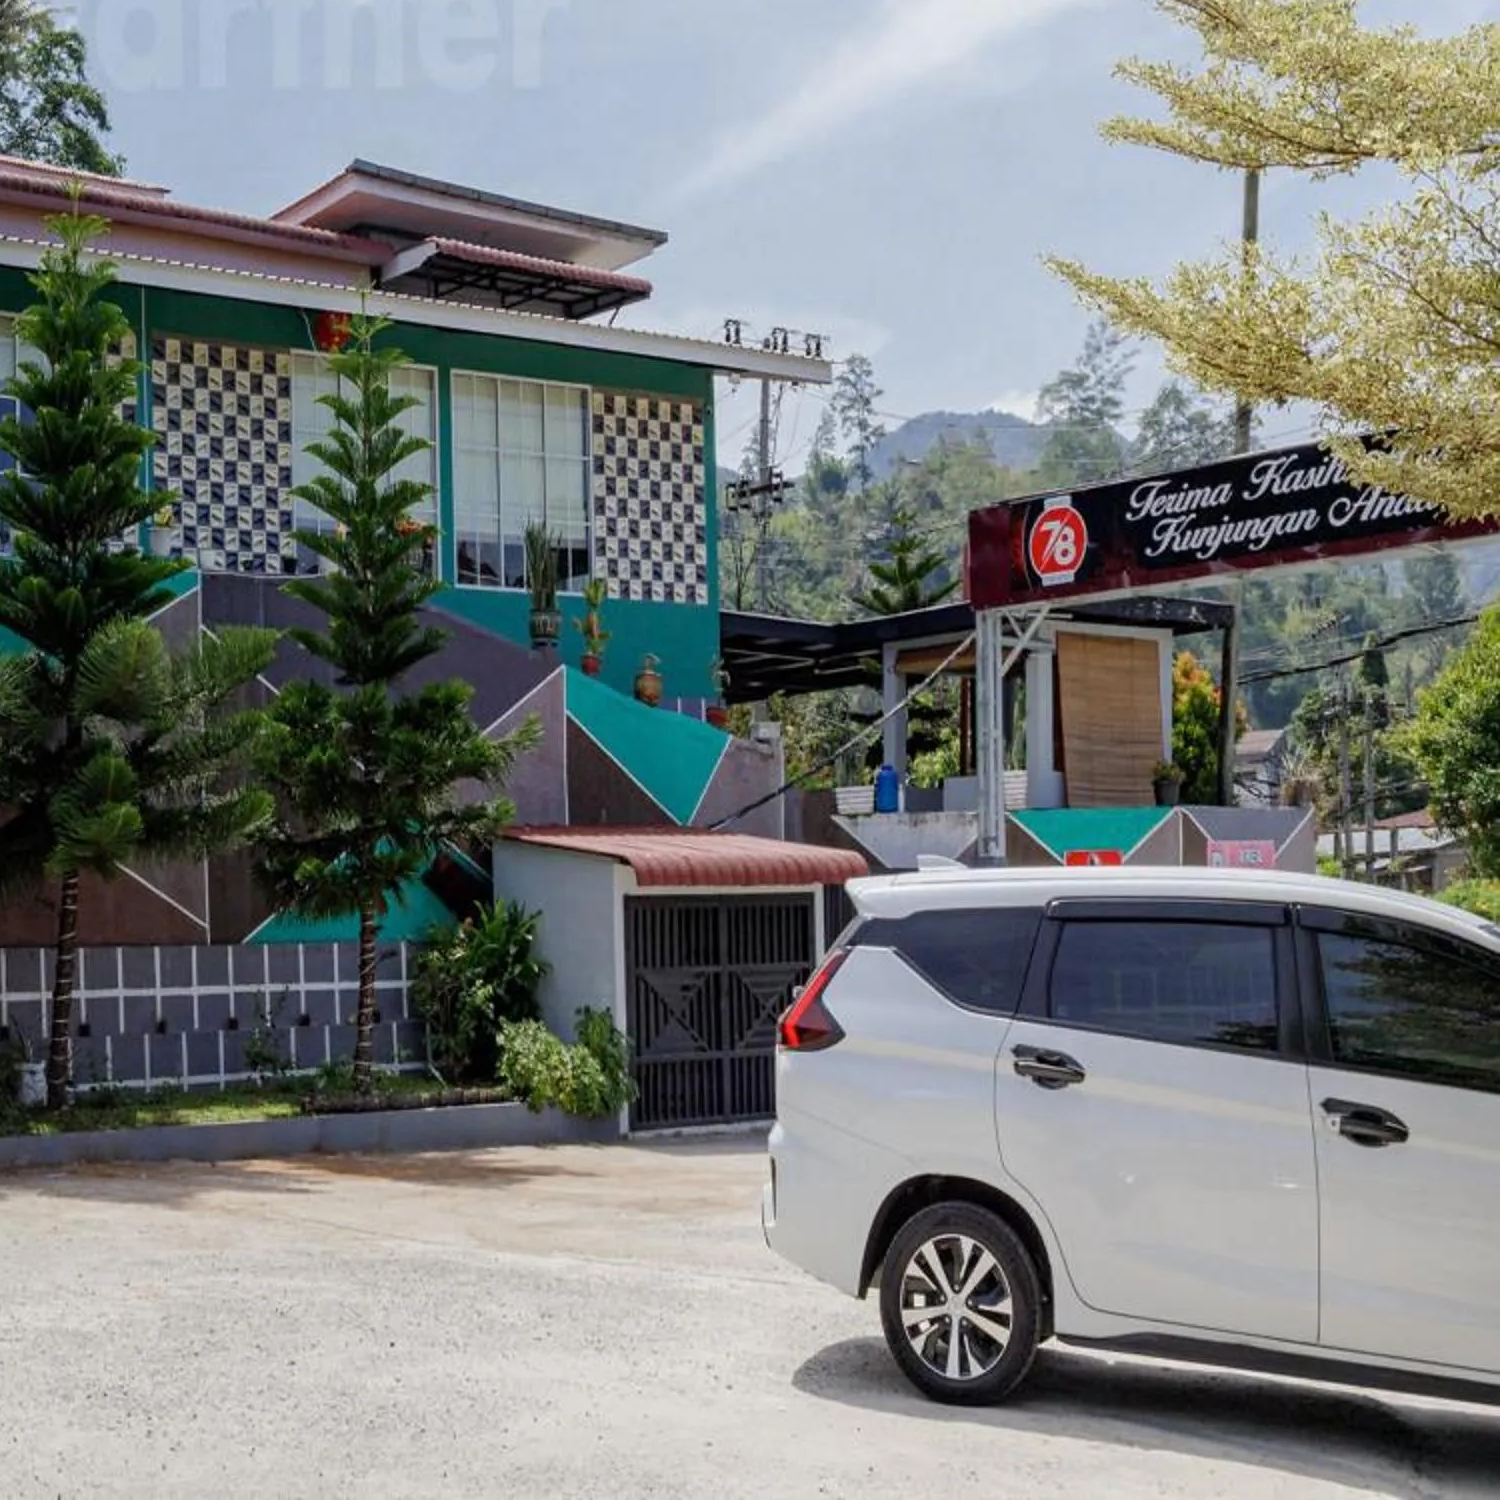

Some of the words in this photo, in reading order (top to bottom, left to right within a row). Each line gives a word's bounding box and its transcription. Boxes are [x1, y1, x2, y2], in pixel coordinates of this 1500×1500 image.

[1125, 479, 1234, 521] Terima
[1242, 453, 1349, 501] Kasih
[1040, 520, 1077, 566] 78
[1144, 507, 1321, 560] Kunjungan
